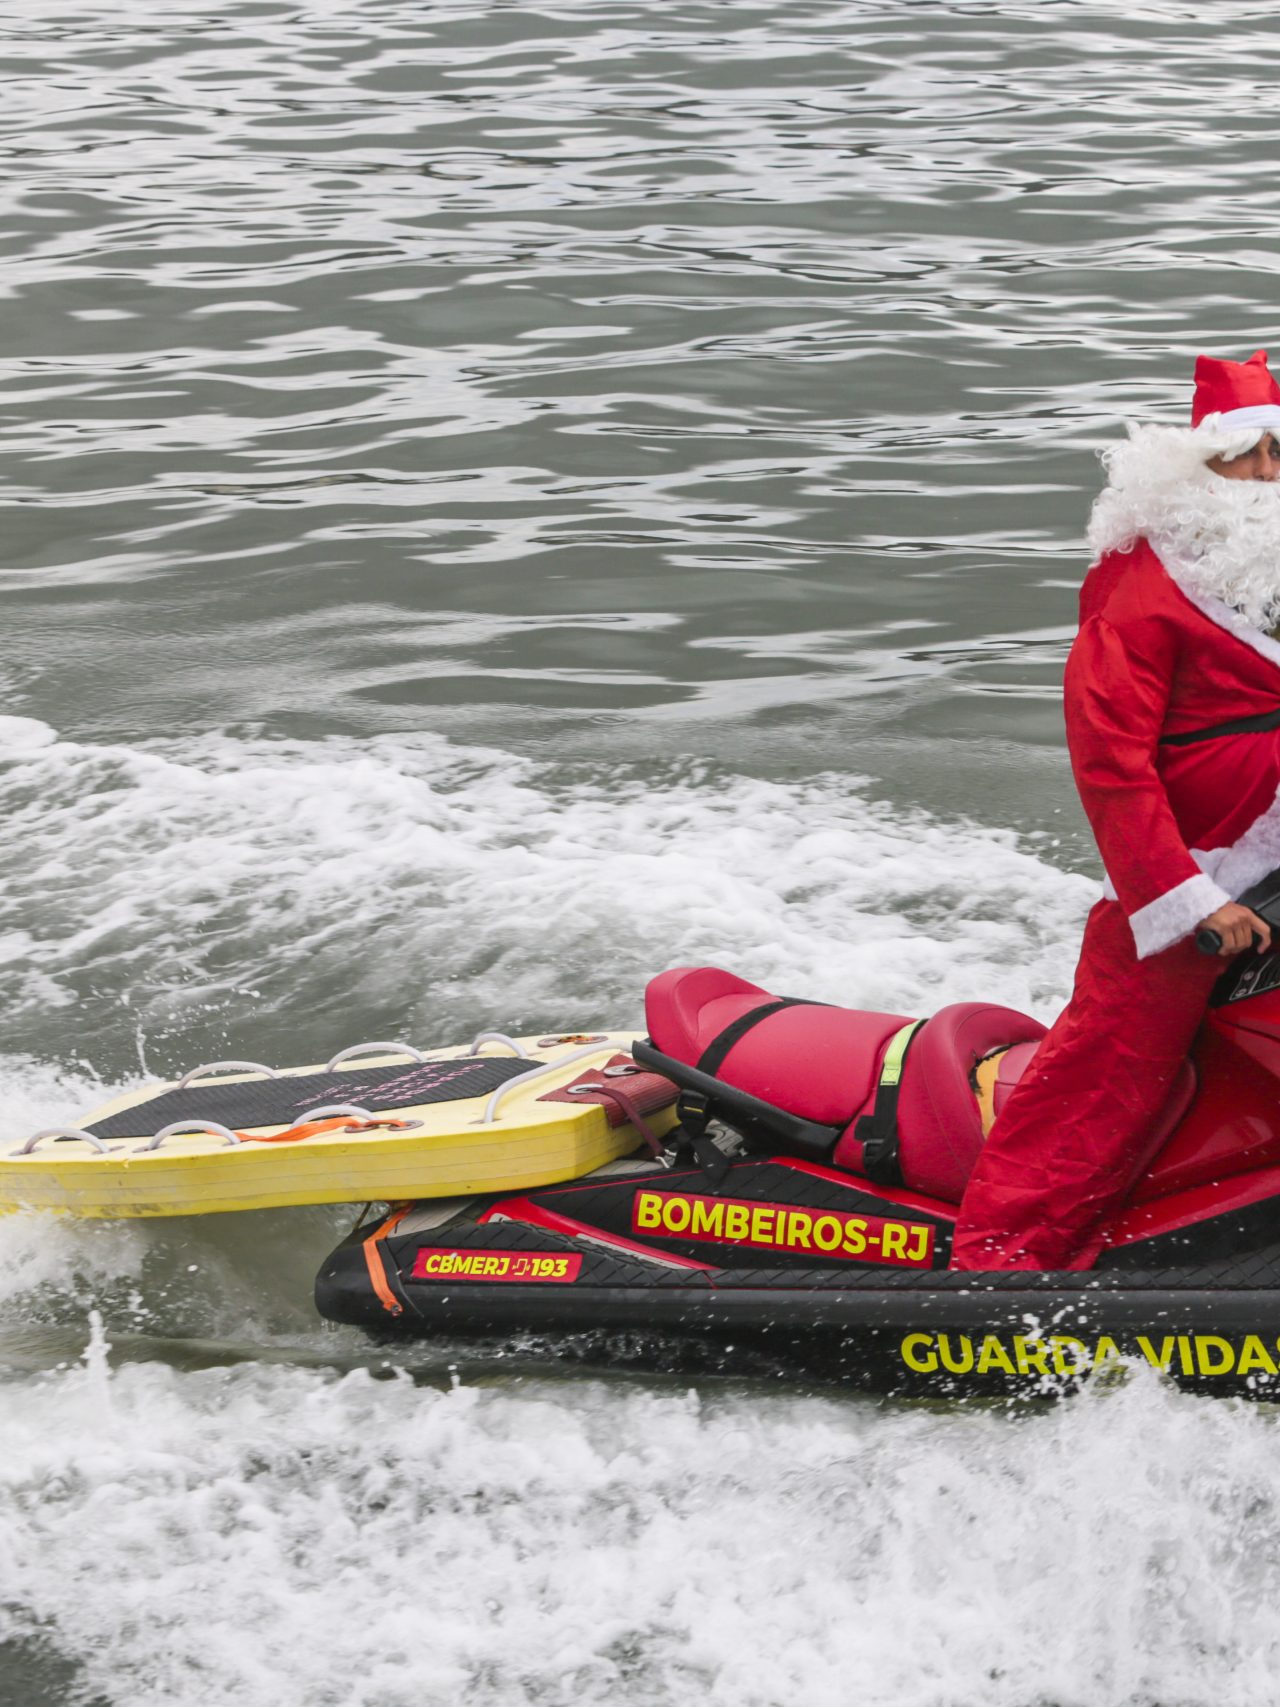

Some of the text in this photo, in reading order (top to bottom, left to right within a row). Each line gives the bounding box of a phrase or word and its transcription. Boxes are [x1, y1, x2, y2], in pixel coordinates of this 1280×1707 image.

[637, 1193, 929, 1261] BOMBEIROS-RJ
[425, 1254, 569, 1277] CBMERJ 193
